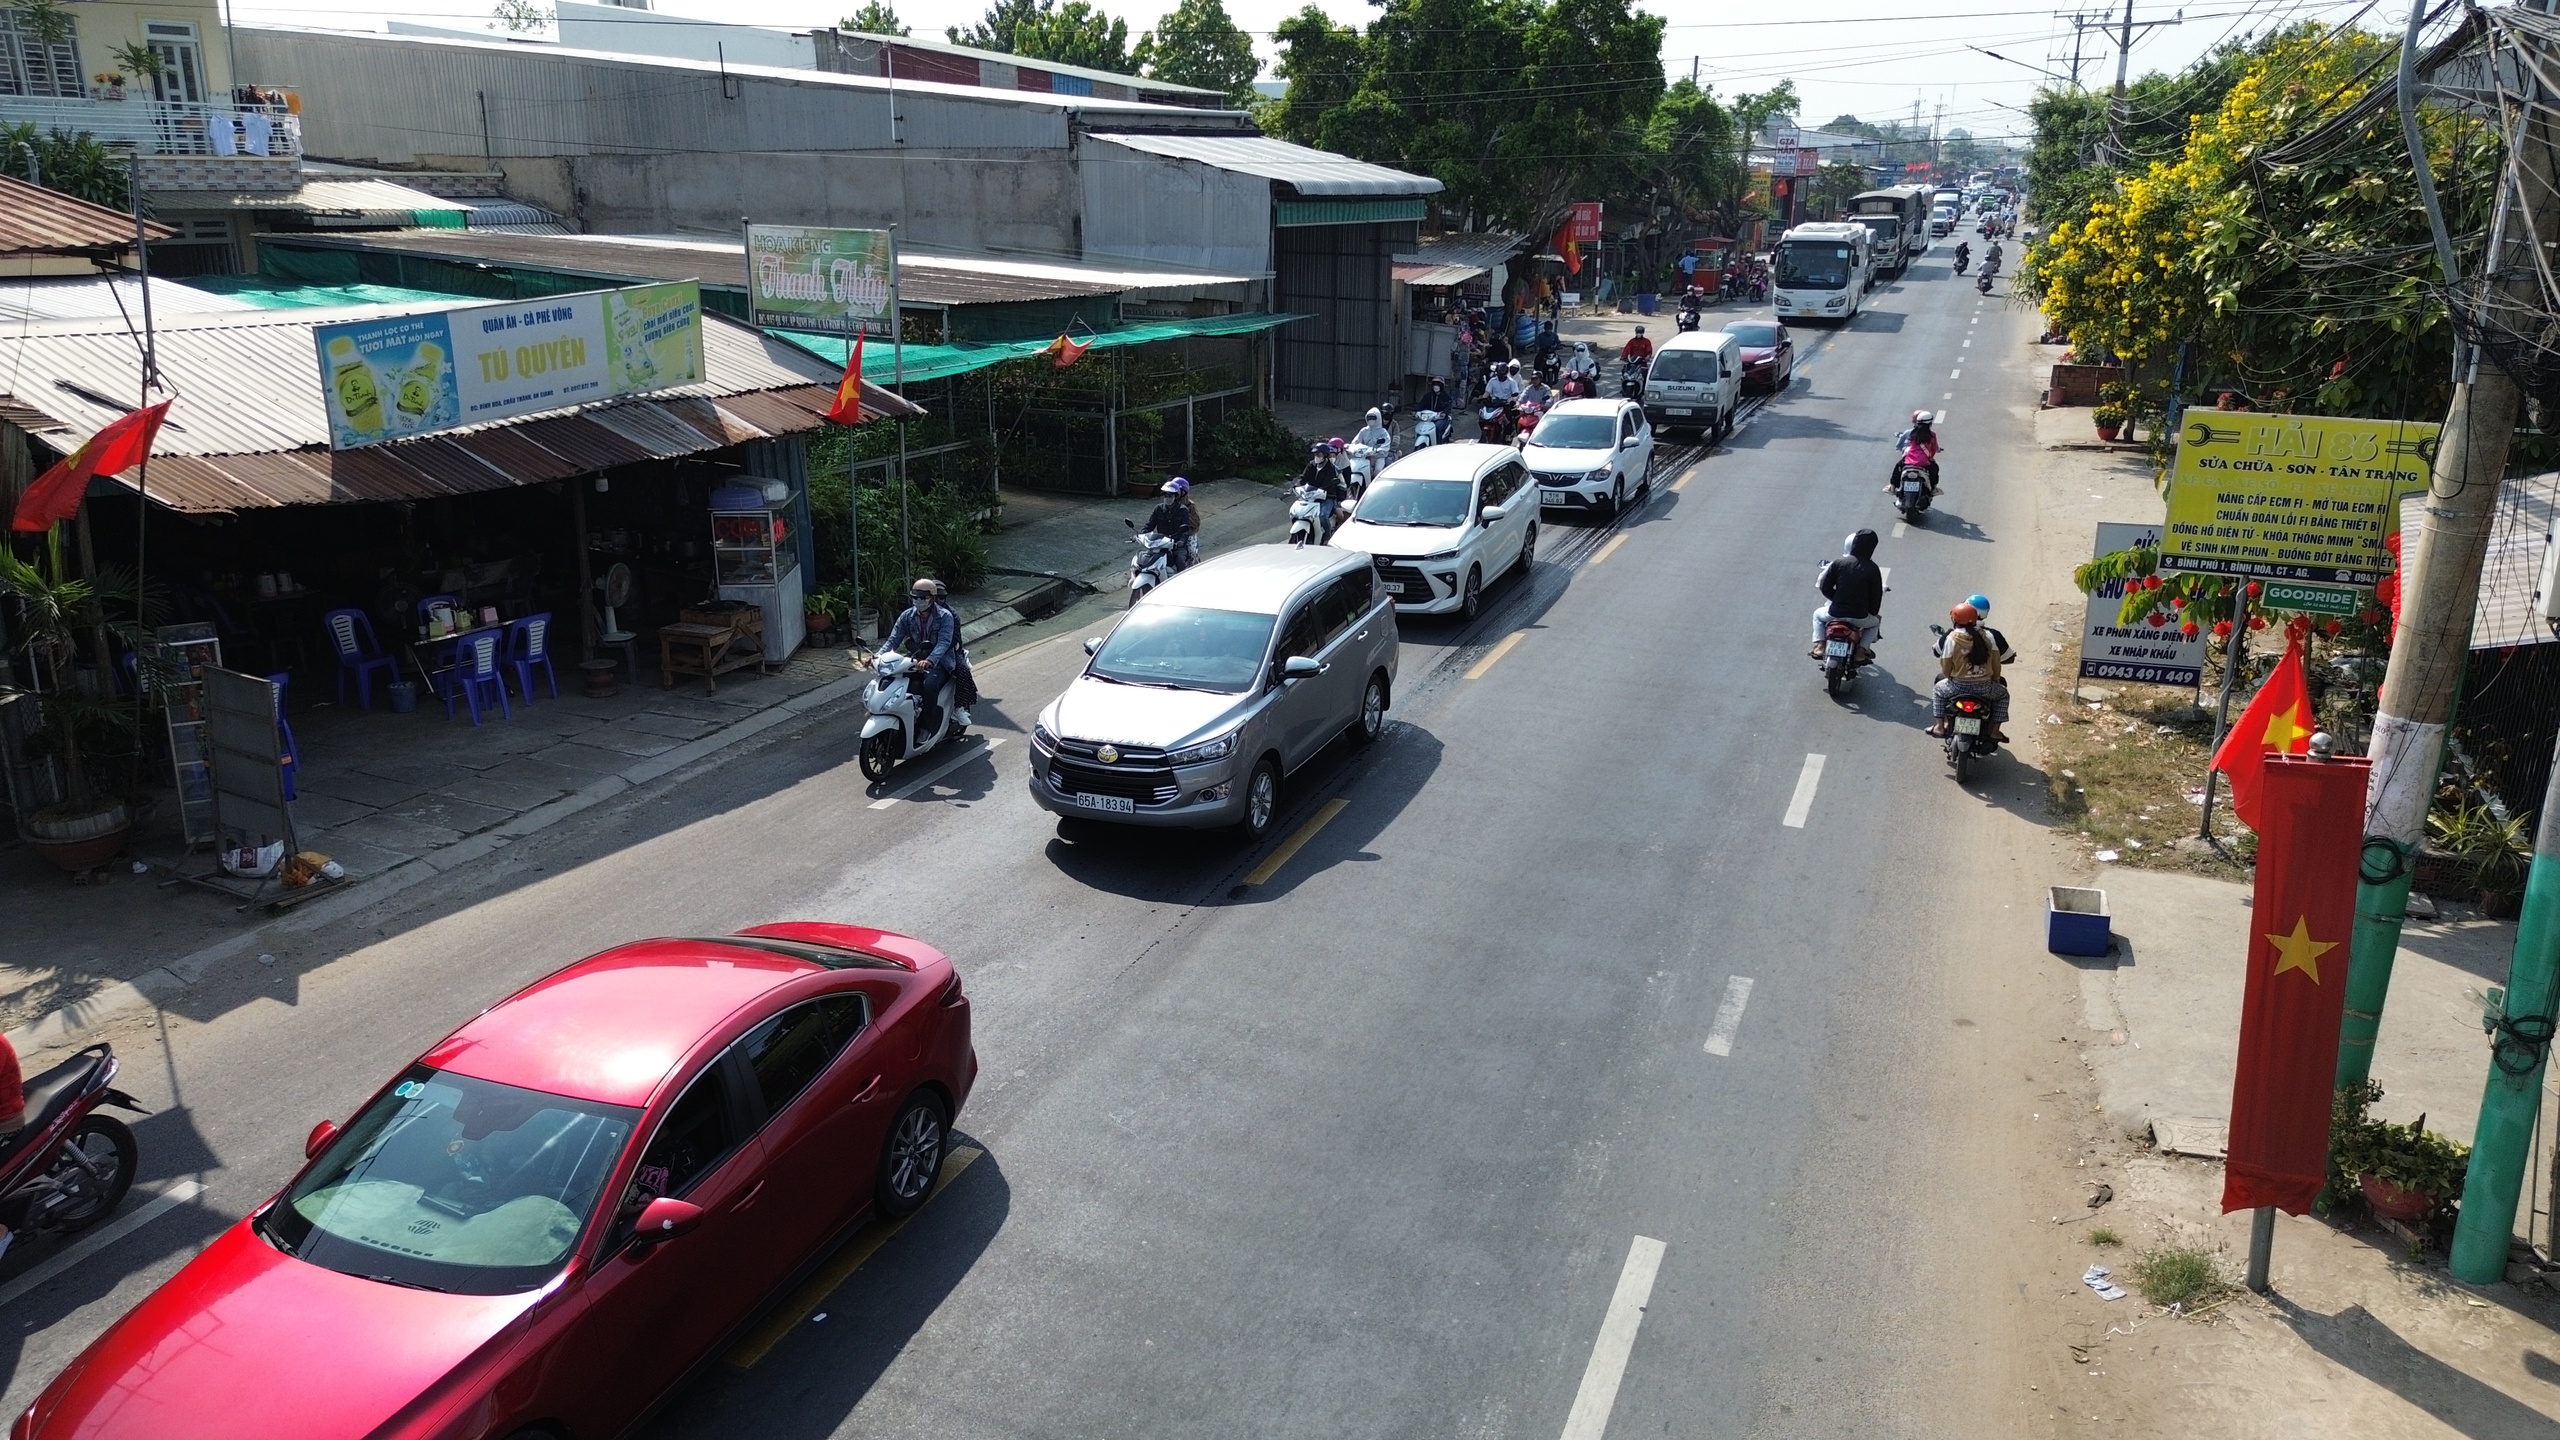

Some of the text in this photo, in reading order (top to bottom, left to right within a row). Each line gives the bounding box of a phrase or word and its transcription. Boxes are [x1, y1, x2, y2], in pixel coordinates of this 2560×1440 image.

[482, 316, 505, 334] QUÁN
[523, 311, 535, 327] CÀ
[536, 308, 551, 325] PHÊ
[357, 331, 383, 343] THANH
[384, 326, 398, 337] LỌC
[385, 334, 407, 348] MÁT
[477, 335, 586, 384] TÚ QUYÊN
[2247, 421, 2378, 462] HẢI 86
[2199, 456, 2228, 470] SỬA
[2233, 459, 2274, 473] CHỮA
[2286, 464, 2317, 475] SƠN
[2329, 465, 2361, 478] TÂN
[2365, 469, 2418, 482] TRANG
[2217, 492, 2244, 505] NÂNG
[2247, 491, 2267, 506] CẤP
[2269, 497, 2291, 508] ECM
[2294, 499, 2303, 508] FI
[2312, 496, 2329, 510] MỞ
[2331, 501, 2349, 512] TUA
[2352, 503, 2374, 514] ECM
[2377, 505, 2386, 515] FI
[2251, 512, 2279, 525] ĐOÁN
[2299, 516, 2308, 526] FI
[2341, 517, 2368, 531] THIẾT
[2216, 525, 2239, 540] ĐIỆN
[2263, 528, 2289, 542] KHÓA
[2292, 531, 2324, 546] THÔNG
[2326, 535, 2354, 547] MINH
[2180, 540, 2192, 553] VỆ
[2195, 541, 2218, 554] SINH
[2220, 544, 2240, 556] KIM
[2243, 546, 2269, 558] PHUN
[2314, 547, 2333, 563] ĐỐT
[2177, 556, 2199, 569] BÌNH
[2200, 558, 2218, 571] PHÚ
[2230, 561, 2251, 574] BÌNH
[2276, 566, 2288, 576] CT
[2354, 572, 2376, 583] 0943
[2269, 587, 2352, 604] GOODRIDE
[2092, 626, 2105, 636] XE
[2106, 627, 2131, 639] PHUN
[2133, 627, 2159, 641] XĂNG
[2161, 630, 2183, 646] ĐIỆN
[2109, 646, 2121, 656] XE
[2123, 646, 2148, 660] NHẬP
[2098, 665, 2194, 683] 0943 491 449
